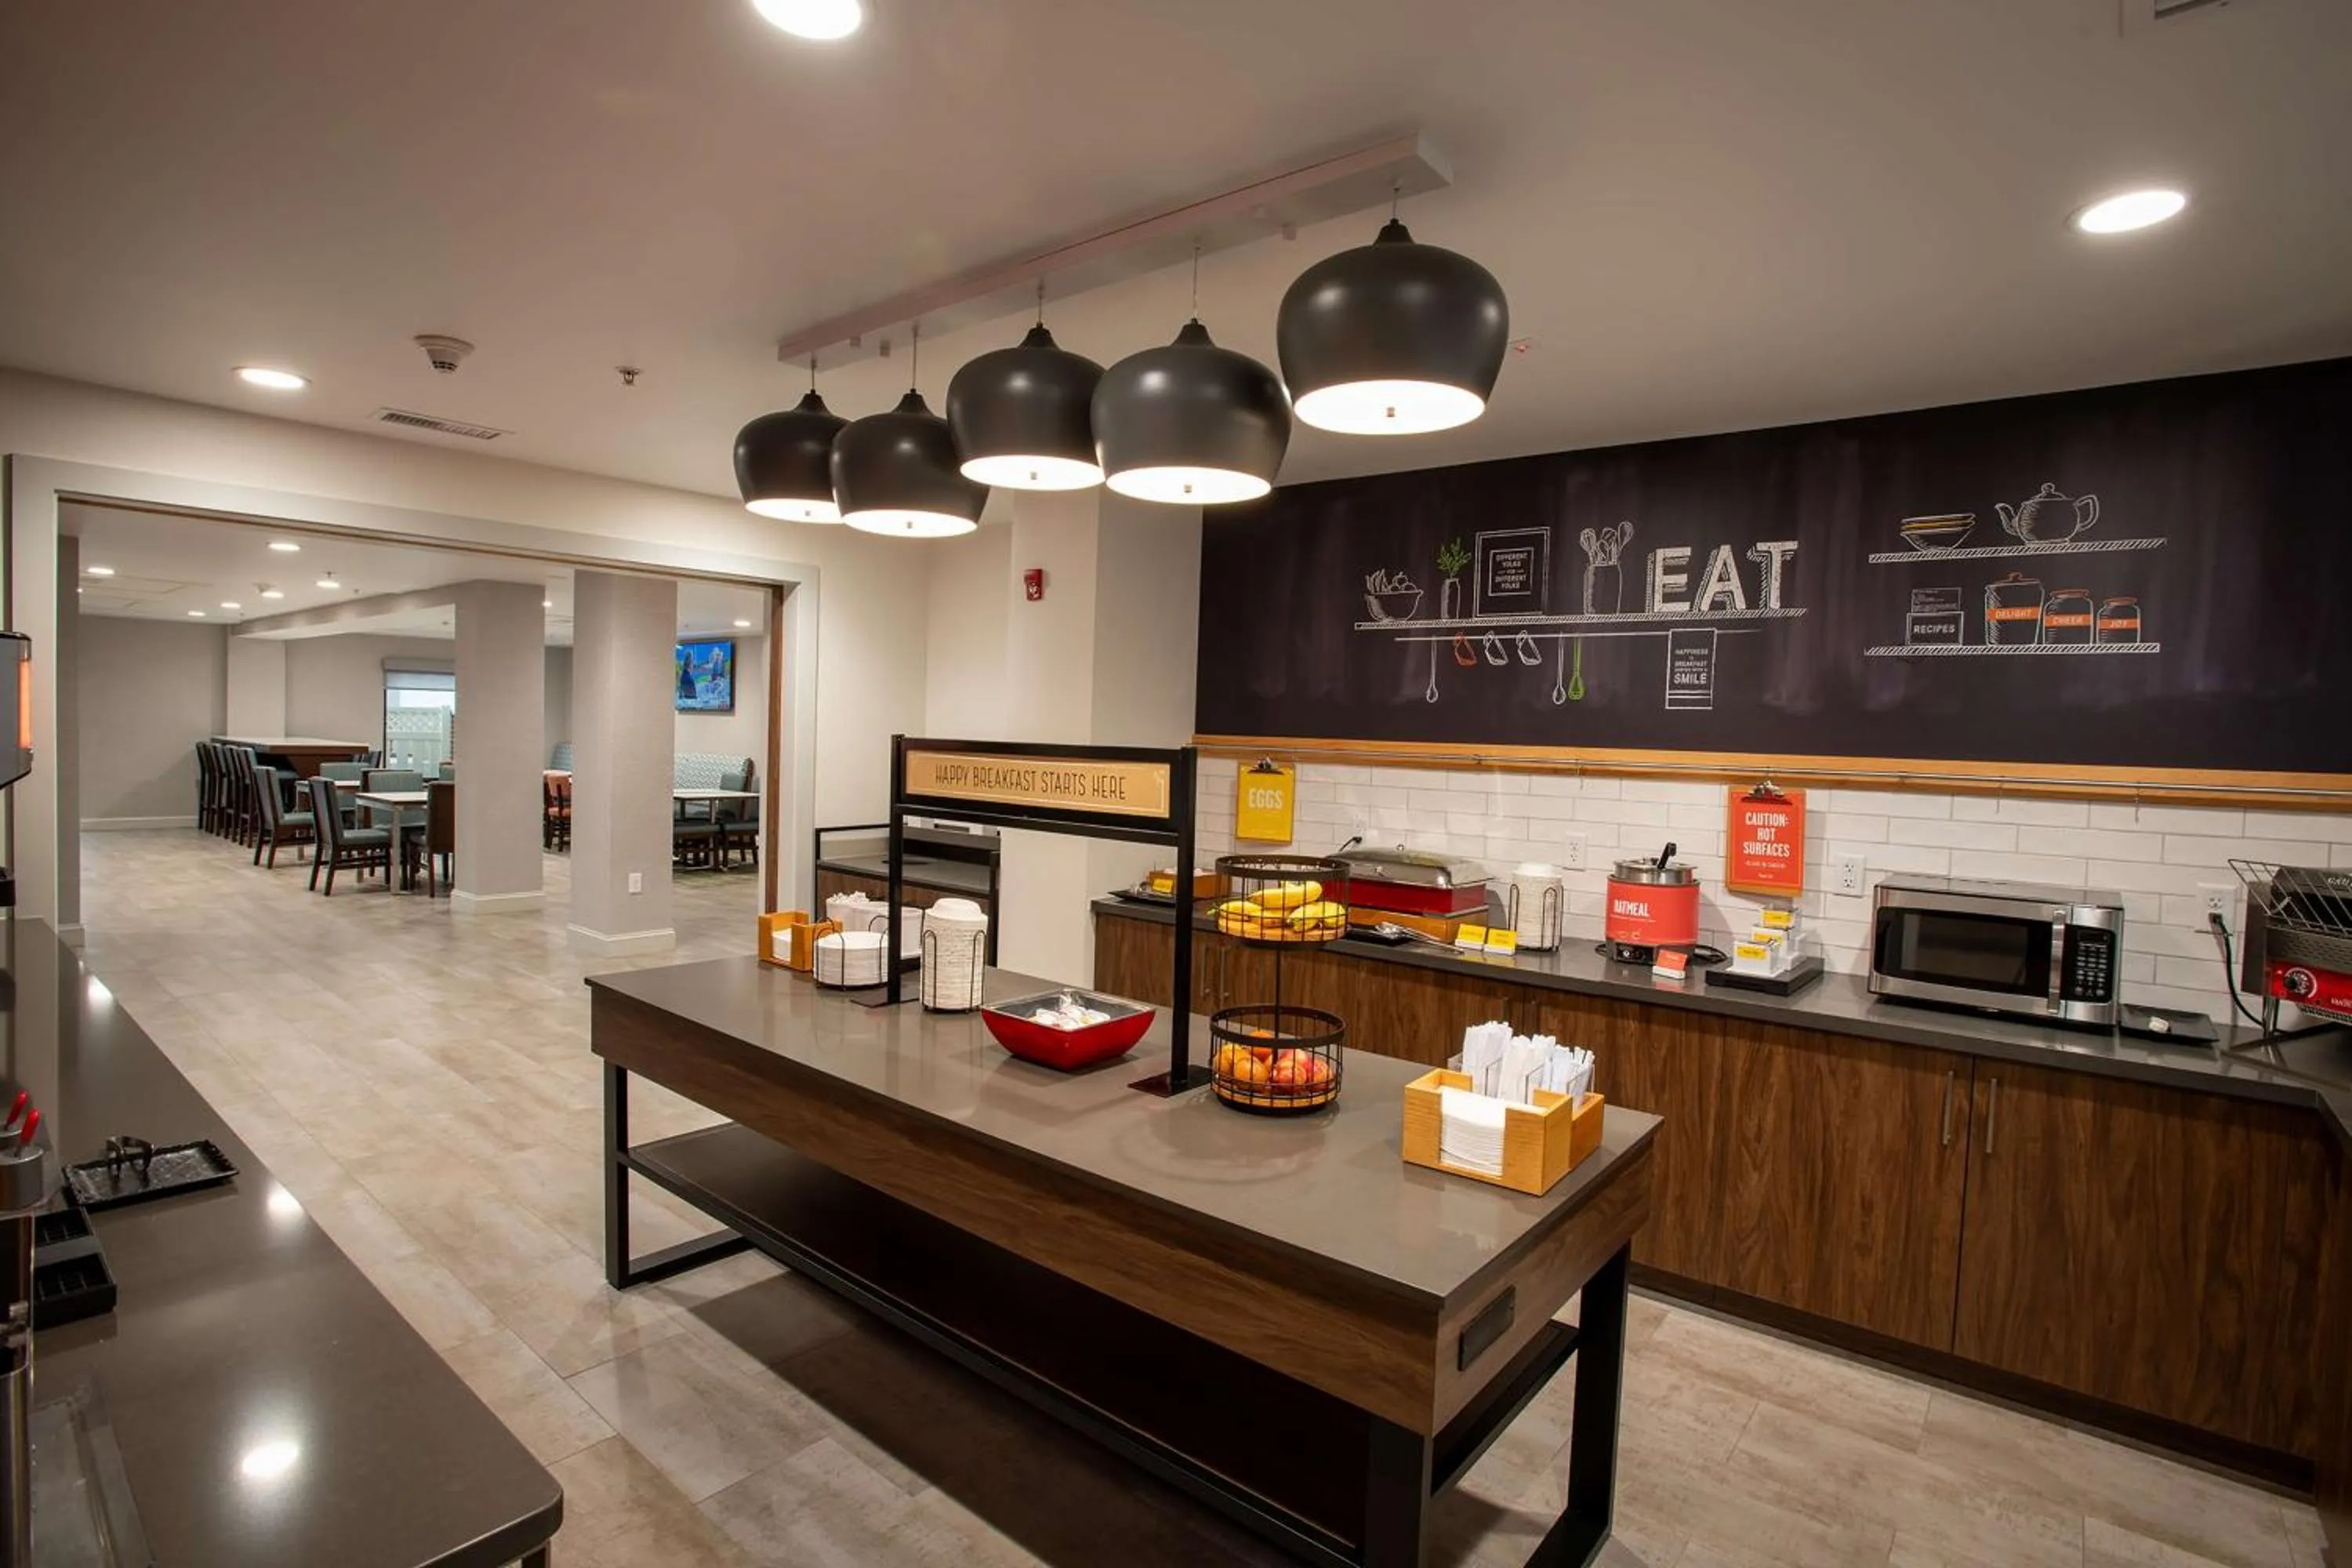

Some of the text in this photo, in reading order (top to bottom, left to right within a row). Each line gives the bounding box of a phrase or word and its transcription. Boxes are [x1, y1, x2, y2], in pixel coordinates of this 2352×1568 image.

[1646, 540, 1798, 612] EAT
[1995, 609, 2032, 619] DELIGHT
[1913, 624, 1955, 633] RECIPES
[1674, 673, 1707, 684] SMILE
[935, 764, 1126, 800] HAPPY BREAKFAST STARTS HERE
[1249, 789, 1283, 809] EGGS
[1745, 812, 1790, 827] CAUTION:
[1757, 827, 1776, 841] HOT
[1743, 841, 1791, 858] SURFACES
[1613, 899, 1650, 916] OATMEAL
